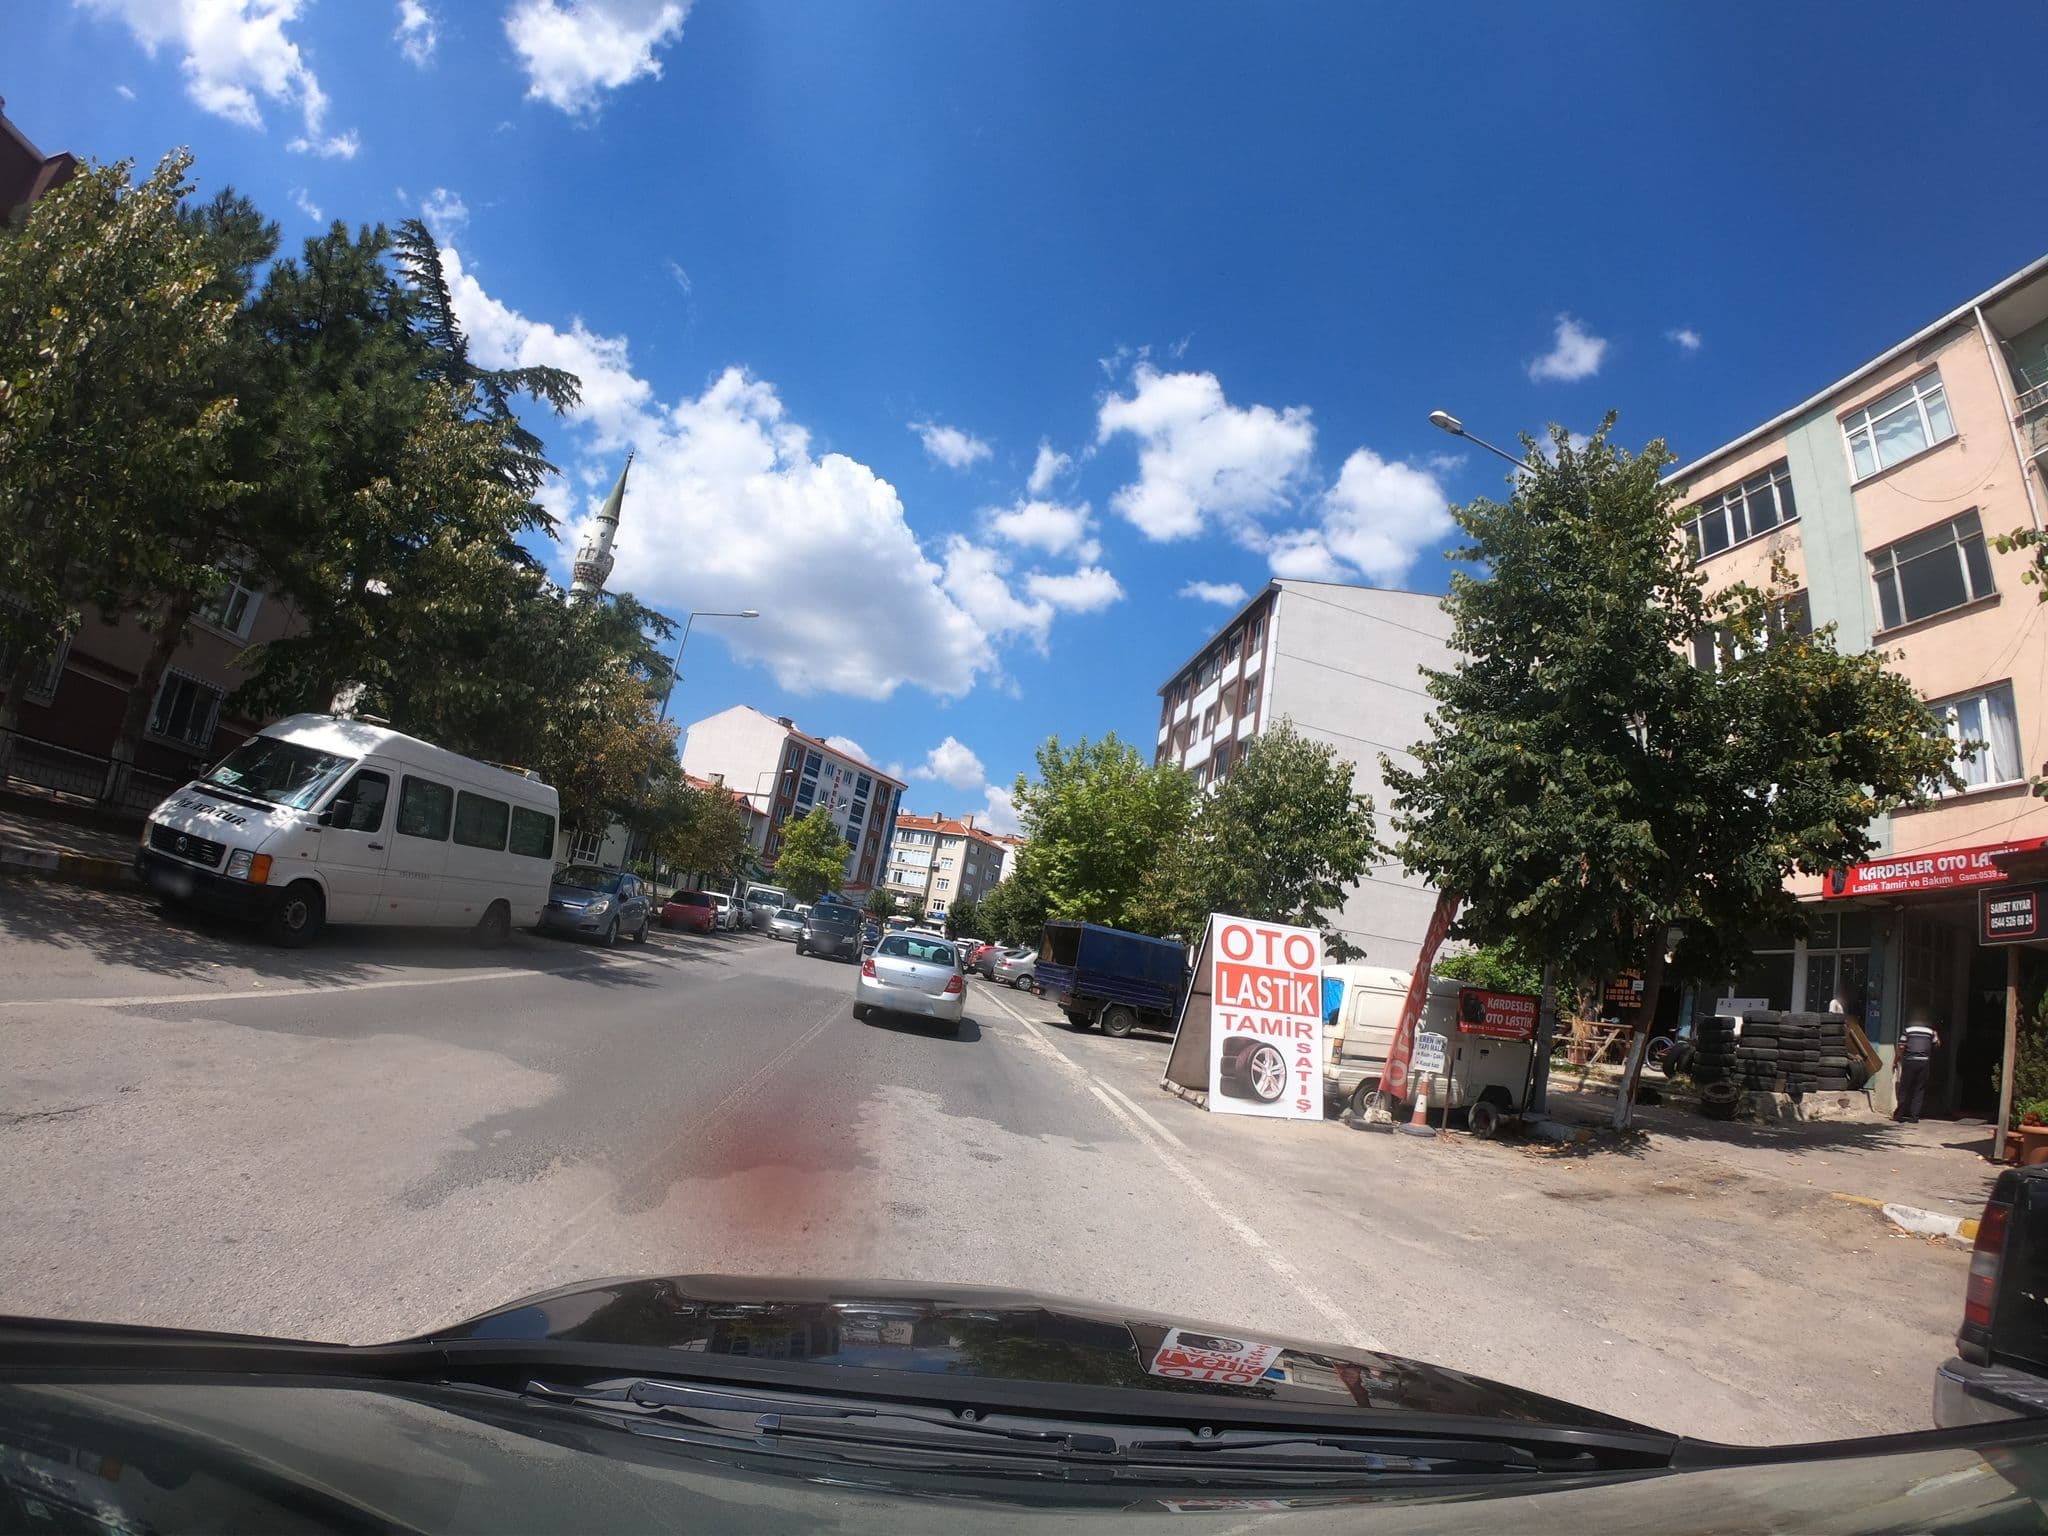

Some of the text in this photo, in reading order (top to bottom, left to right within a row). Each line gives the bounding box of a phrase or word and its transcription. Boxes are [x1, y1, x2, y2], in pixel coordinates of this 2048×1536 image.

[1858, 859, 1934, 882] KARDEŞLER
[1937, 854, 1967, 872] OTO
[1852, 881, 1879, 893] Lastik
[1880, 879, 1907, 890] Tamiri
[1909, 879, 1920, 888] ve
[1922, 875, 1953, 887] Bakımı
[1220, 924, 1315, 971] OTO
[1221, 969, 1314, 1015] LASTİK
[1487, 997, 1535, 1014] KARDEŞLER
[1219, 1012, 1314, 1040] TAMİR
[1485, 1012, 1504, 1025] OTO
[1505, 1014, 1533, 1028] LASTİK
[1295, 1042, 1313, 1113] SATIŞ
